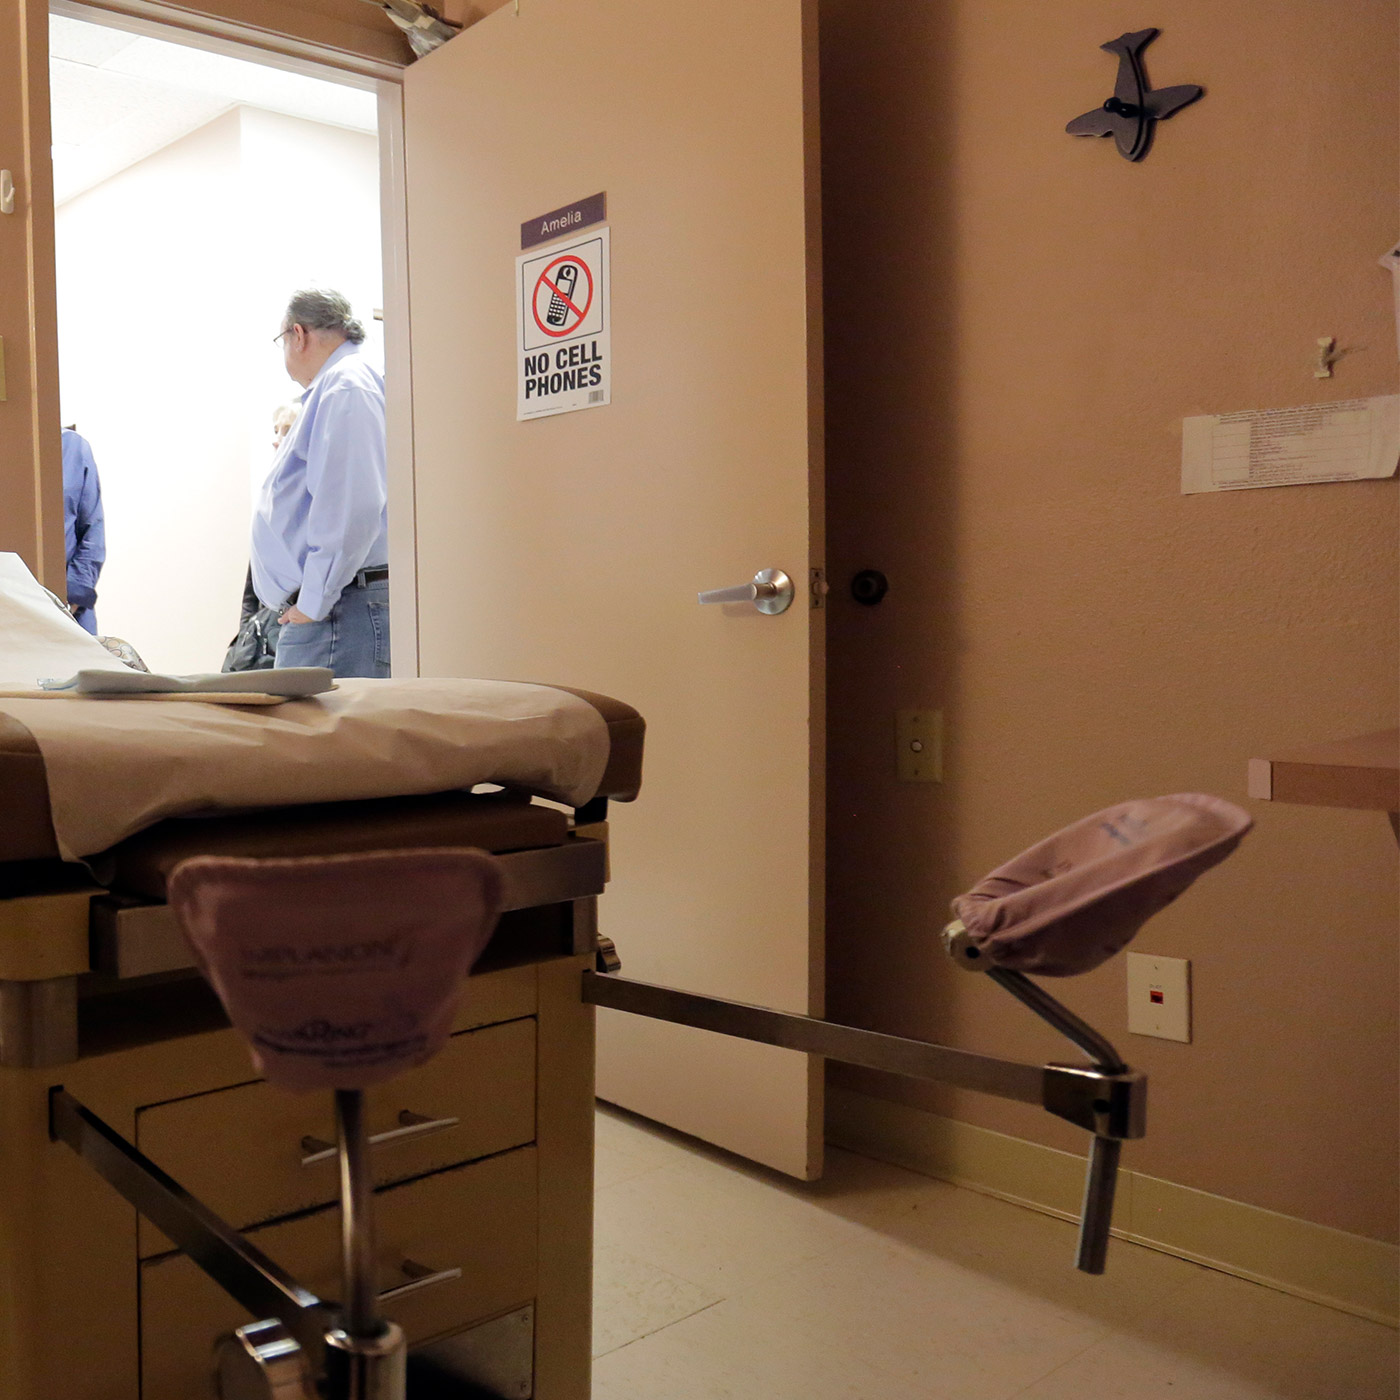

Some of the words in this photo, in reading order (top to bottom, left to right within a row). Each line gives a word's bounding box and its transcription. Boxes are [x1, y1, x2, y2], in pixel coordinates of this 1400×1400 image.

[541, 209, 582, 236] Amelia
[524, 352, 550, 377] NO
[555, 340, 603, 371] CELL
[525, 364, 602, 399] PHONES
